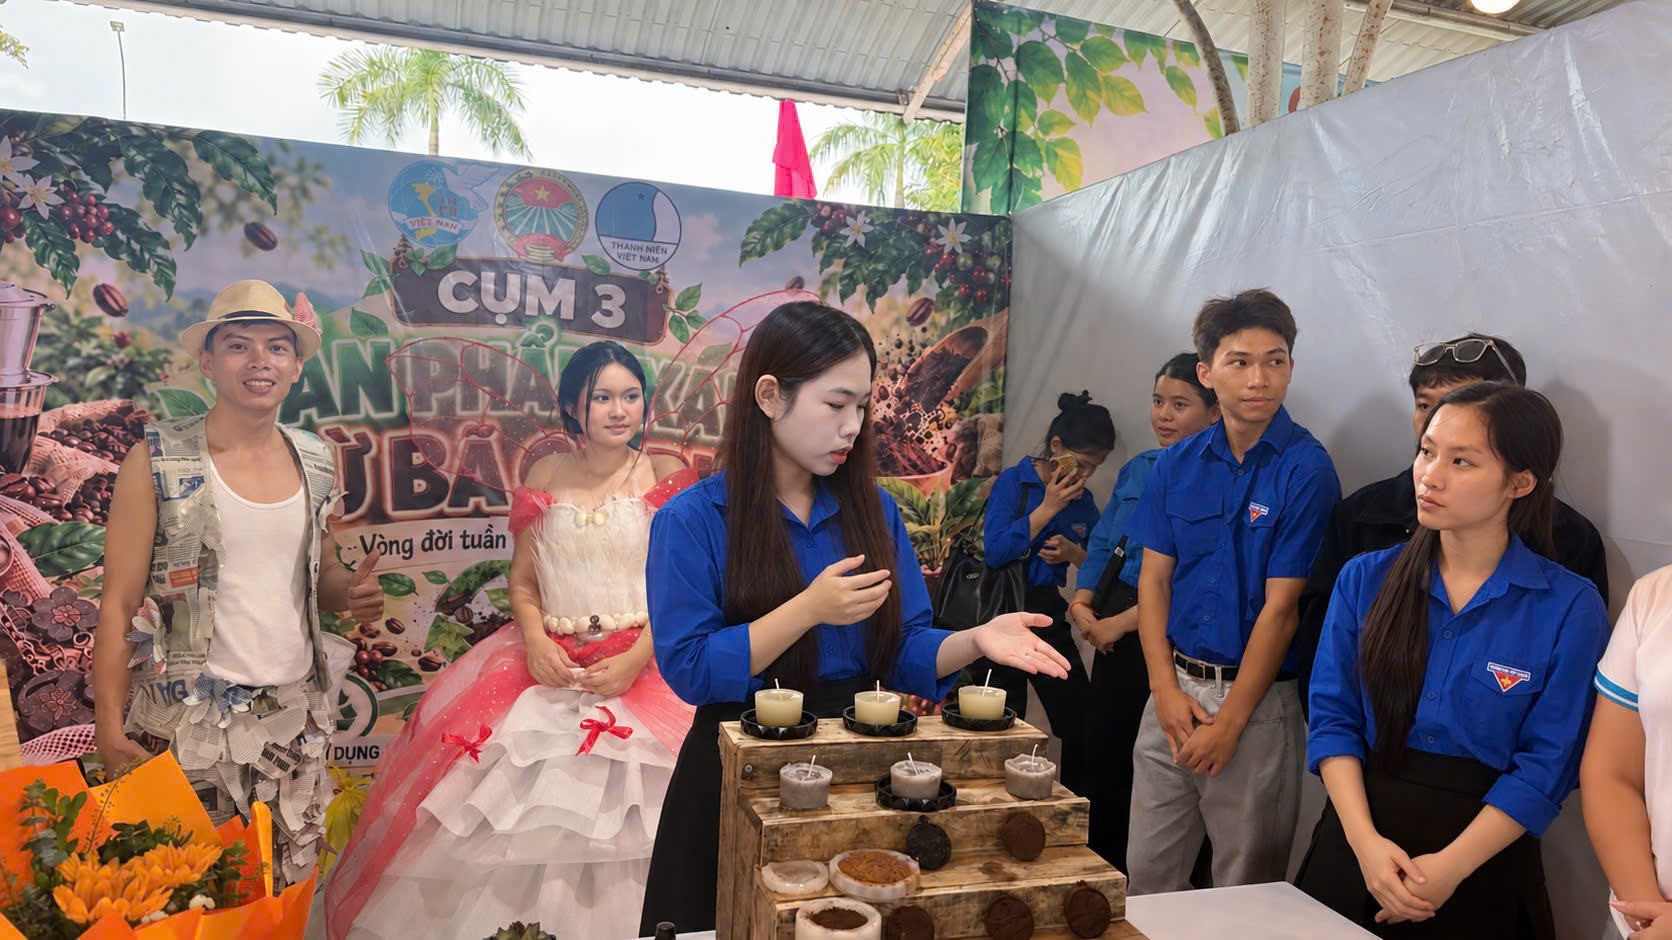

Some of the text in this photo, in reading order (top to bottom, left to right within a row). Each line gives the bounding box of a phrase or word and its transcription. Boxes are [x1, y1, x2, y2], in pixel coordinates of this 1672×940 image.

[611, 241, 643, 252] THANH
[639, 255, 660, 264] NAM
[437, 270, 626, 329] CỤM 3
[359, 524, 507, 561] Vòng đời tuần
[334, 744, 380, 765] DỤNG
